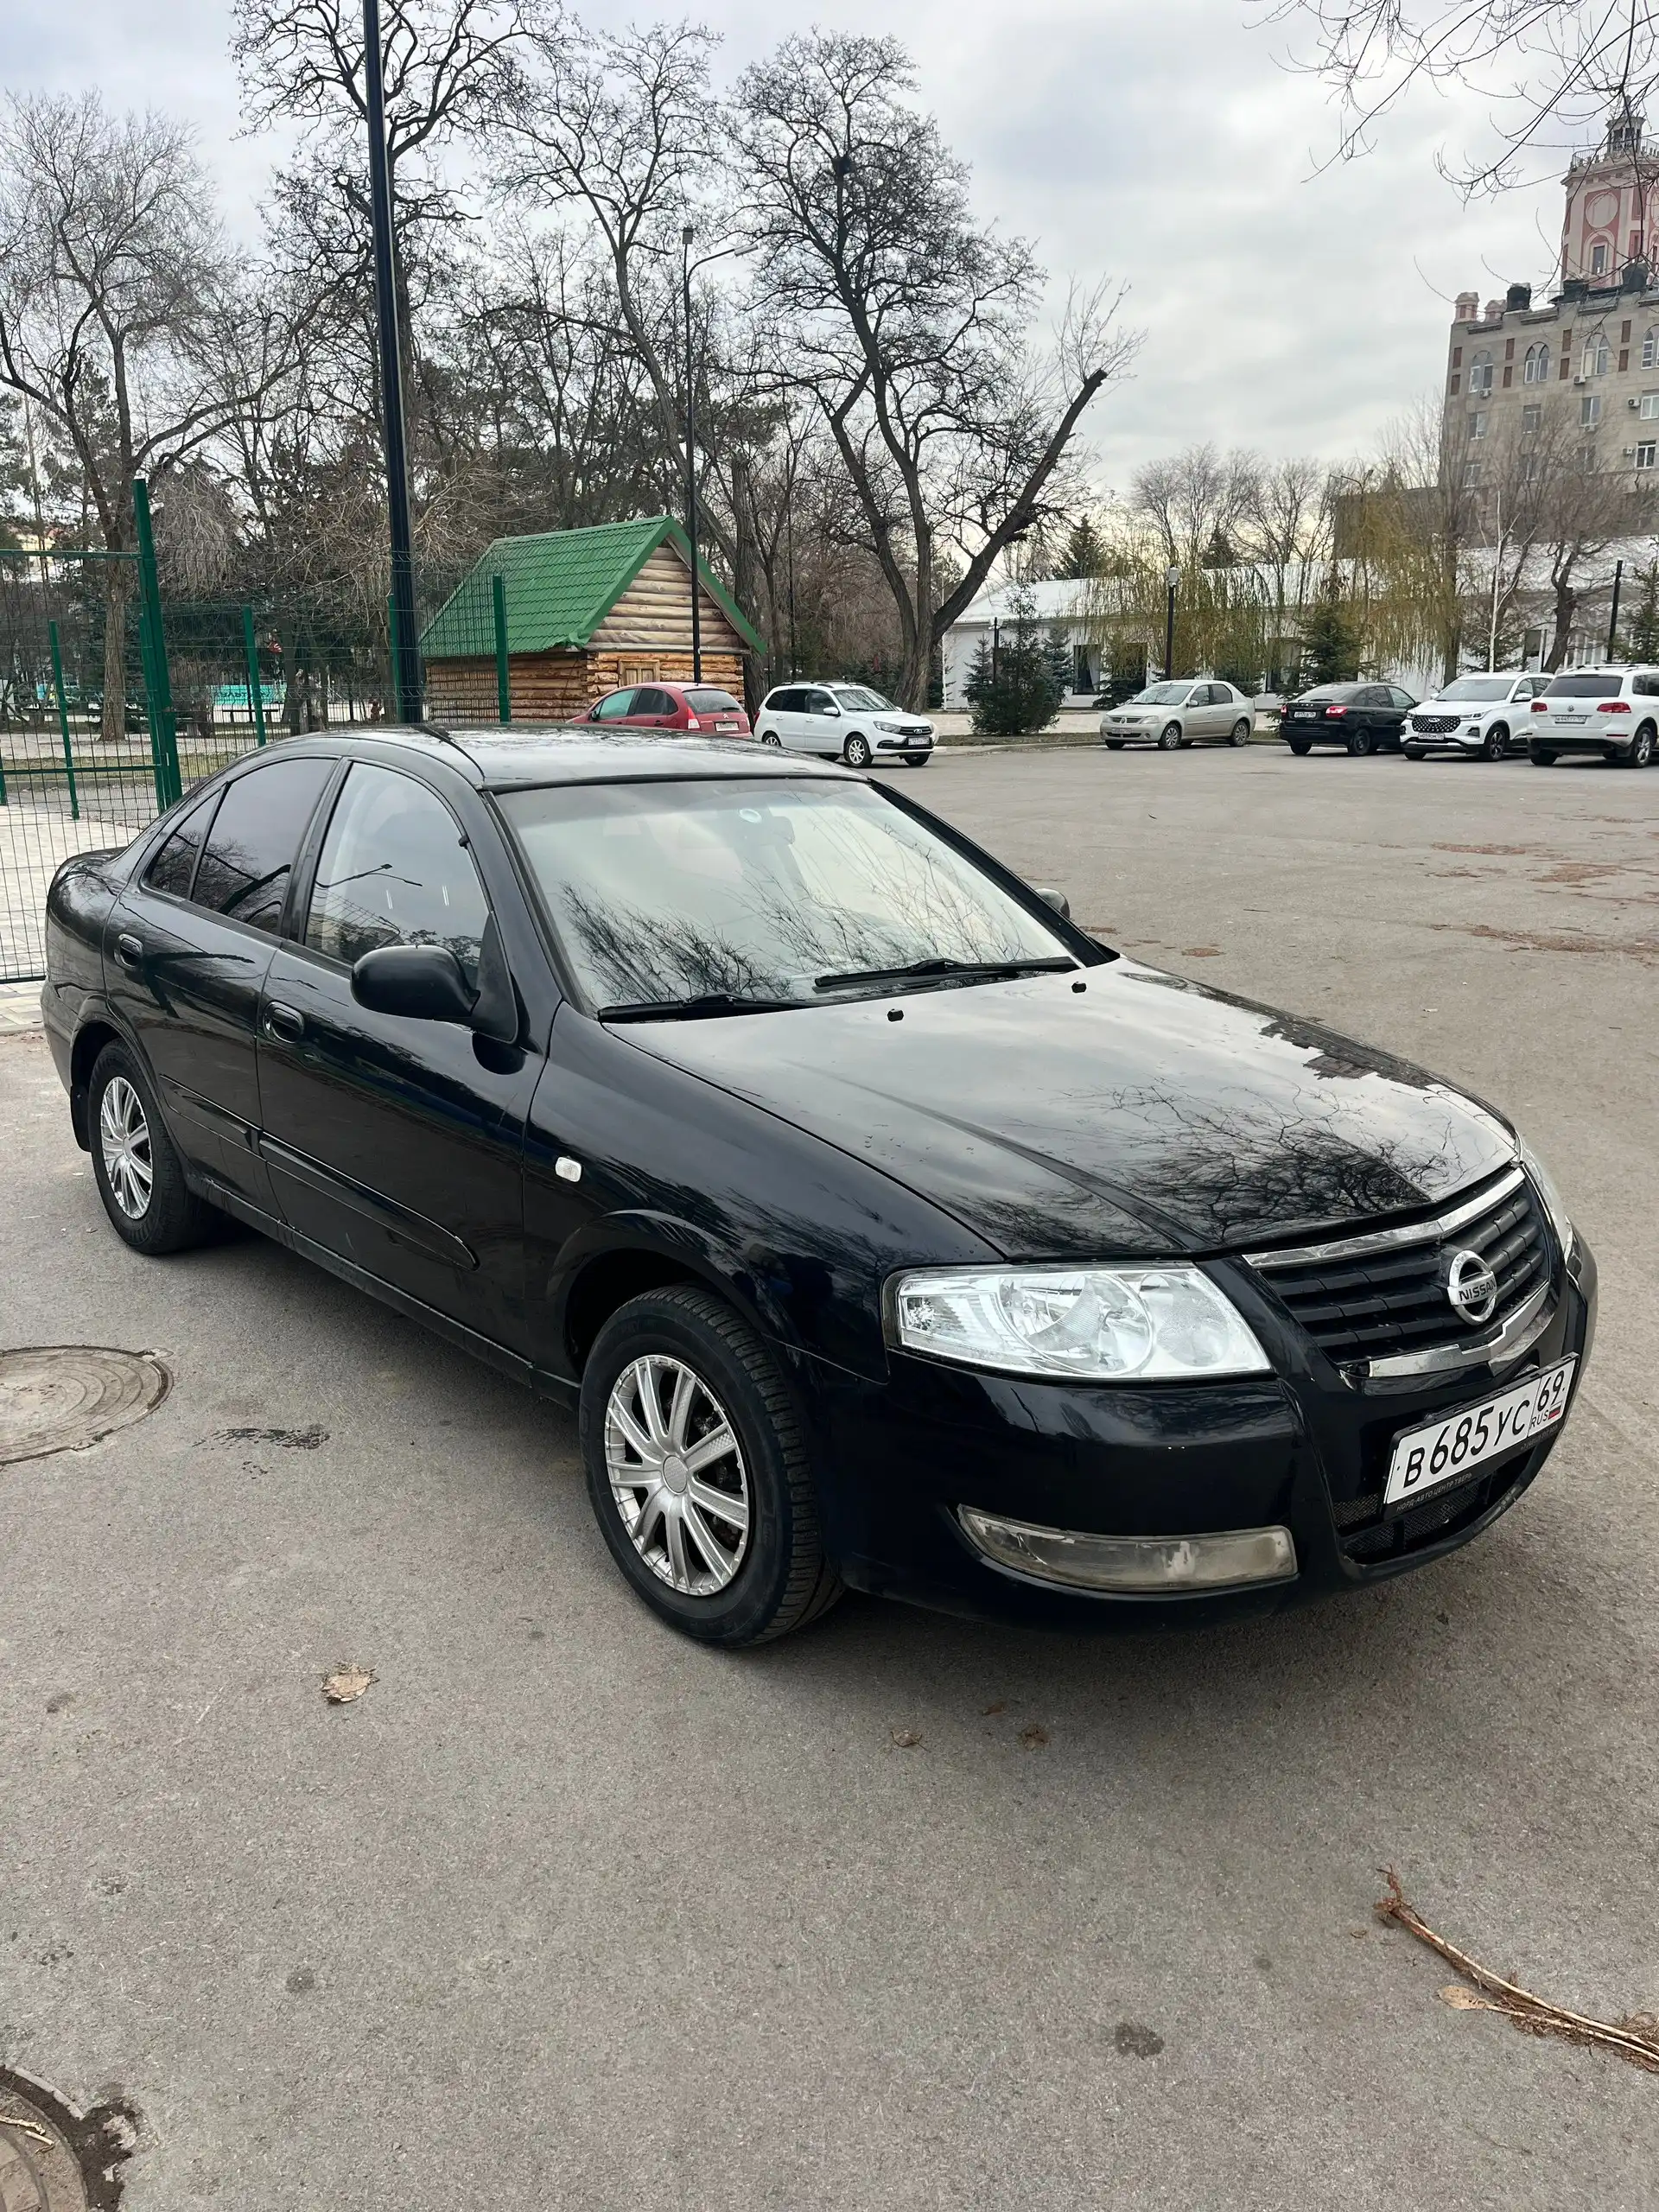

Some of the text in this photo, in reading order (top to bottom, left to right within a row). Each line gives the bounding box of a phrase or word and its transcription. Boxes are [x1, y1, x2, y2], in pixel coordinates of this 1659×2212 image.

[1458, 1279, 1497, 1302] NISSAN
[1402, 1399, 1530, 1489] В685УС
[1537, 1370, 1565, 1412] 69
[1530, 1409, 1549, 1427] RUS
